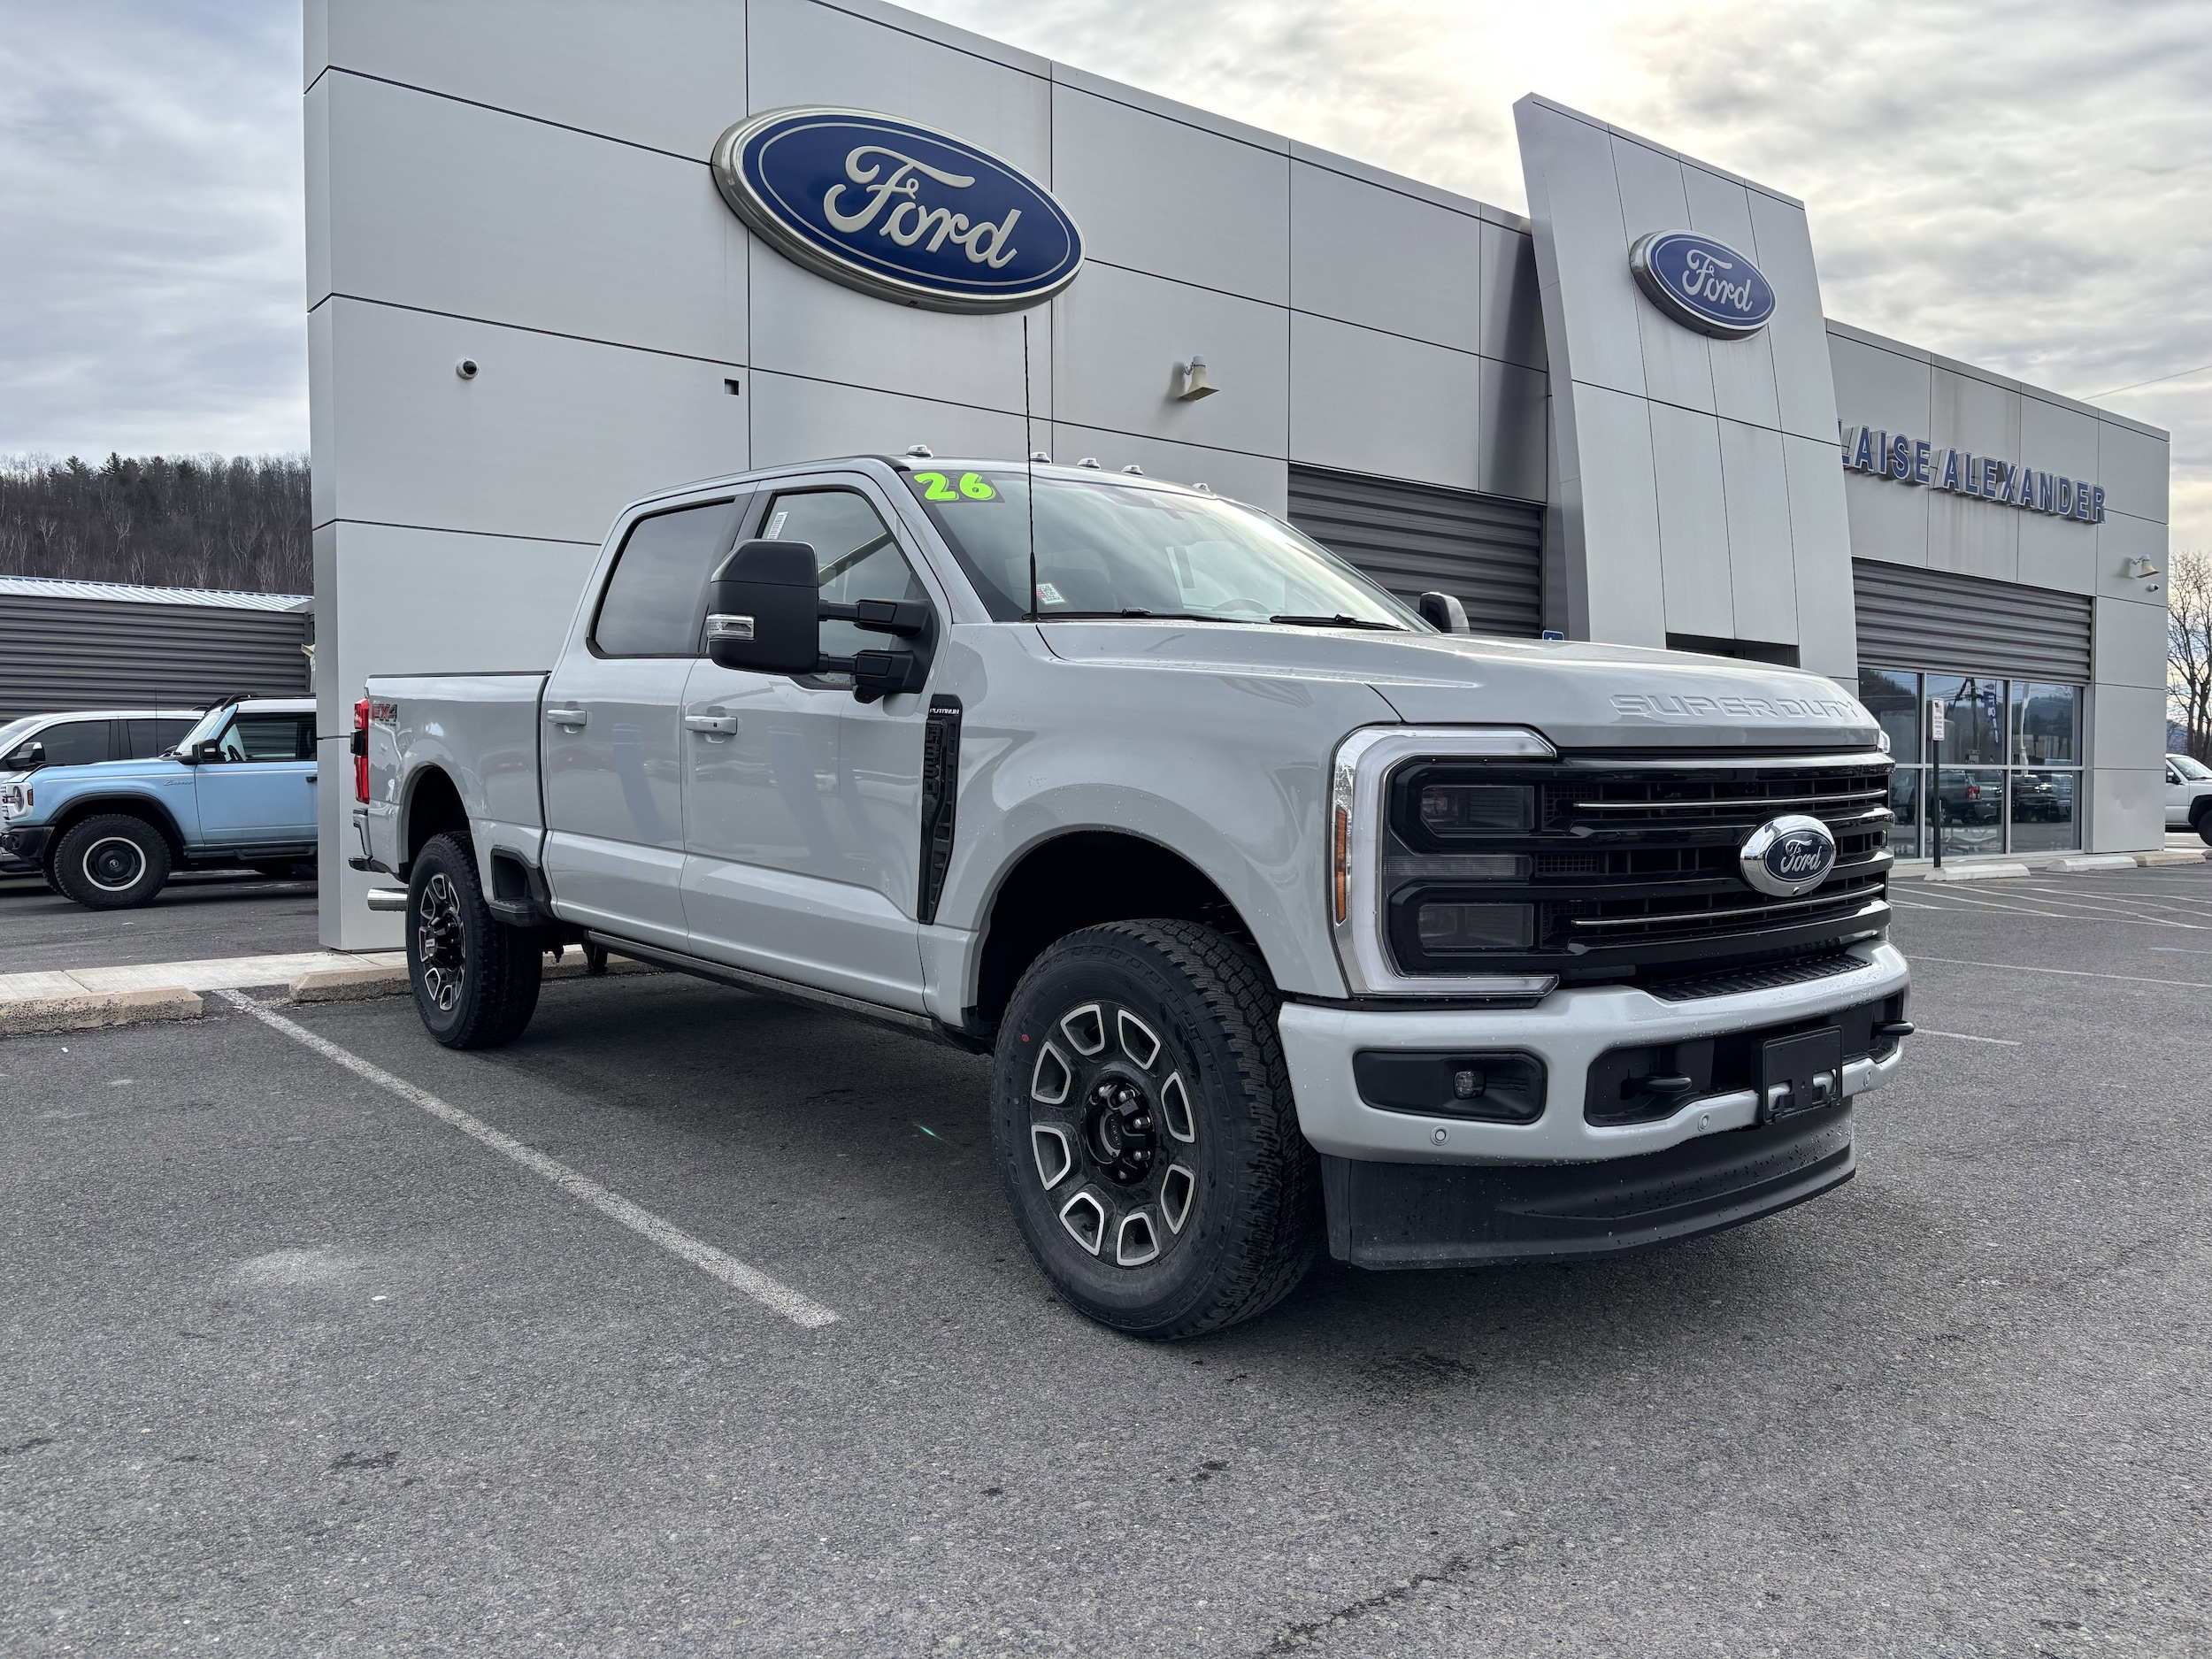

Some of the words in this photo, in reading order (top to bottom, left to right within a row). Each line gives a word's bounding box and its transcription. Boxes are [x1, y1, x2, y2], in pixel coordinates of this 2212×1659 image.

[823, 145, 1022, 270] Ford
[1682, 249, 1753, 312] Ford
[913, 472, 996, 501] 26
[1941, 447, 2107, 524] ALEXANDER
[373, 703, 398, 723] FX4
[1609, 694, 1778, 718] SUPER
[1775, 698, 1860, 718] DUTY
[1780, 839, 1823, 873] Ford
